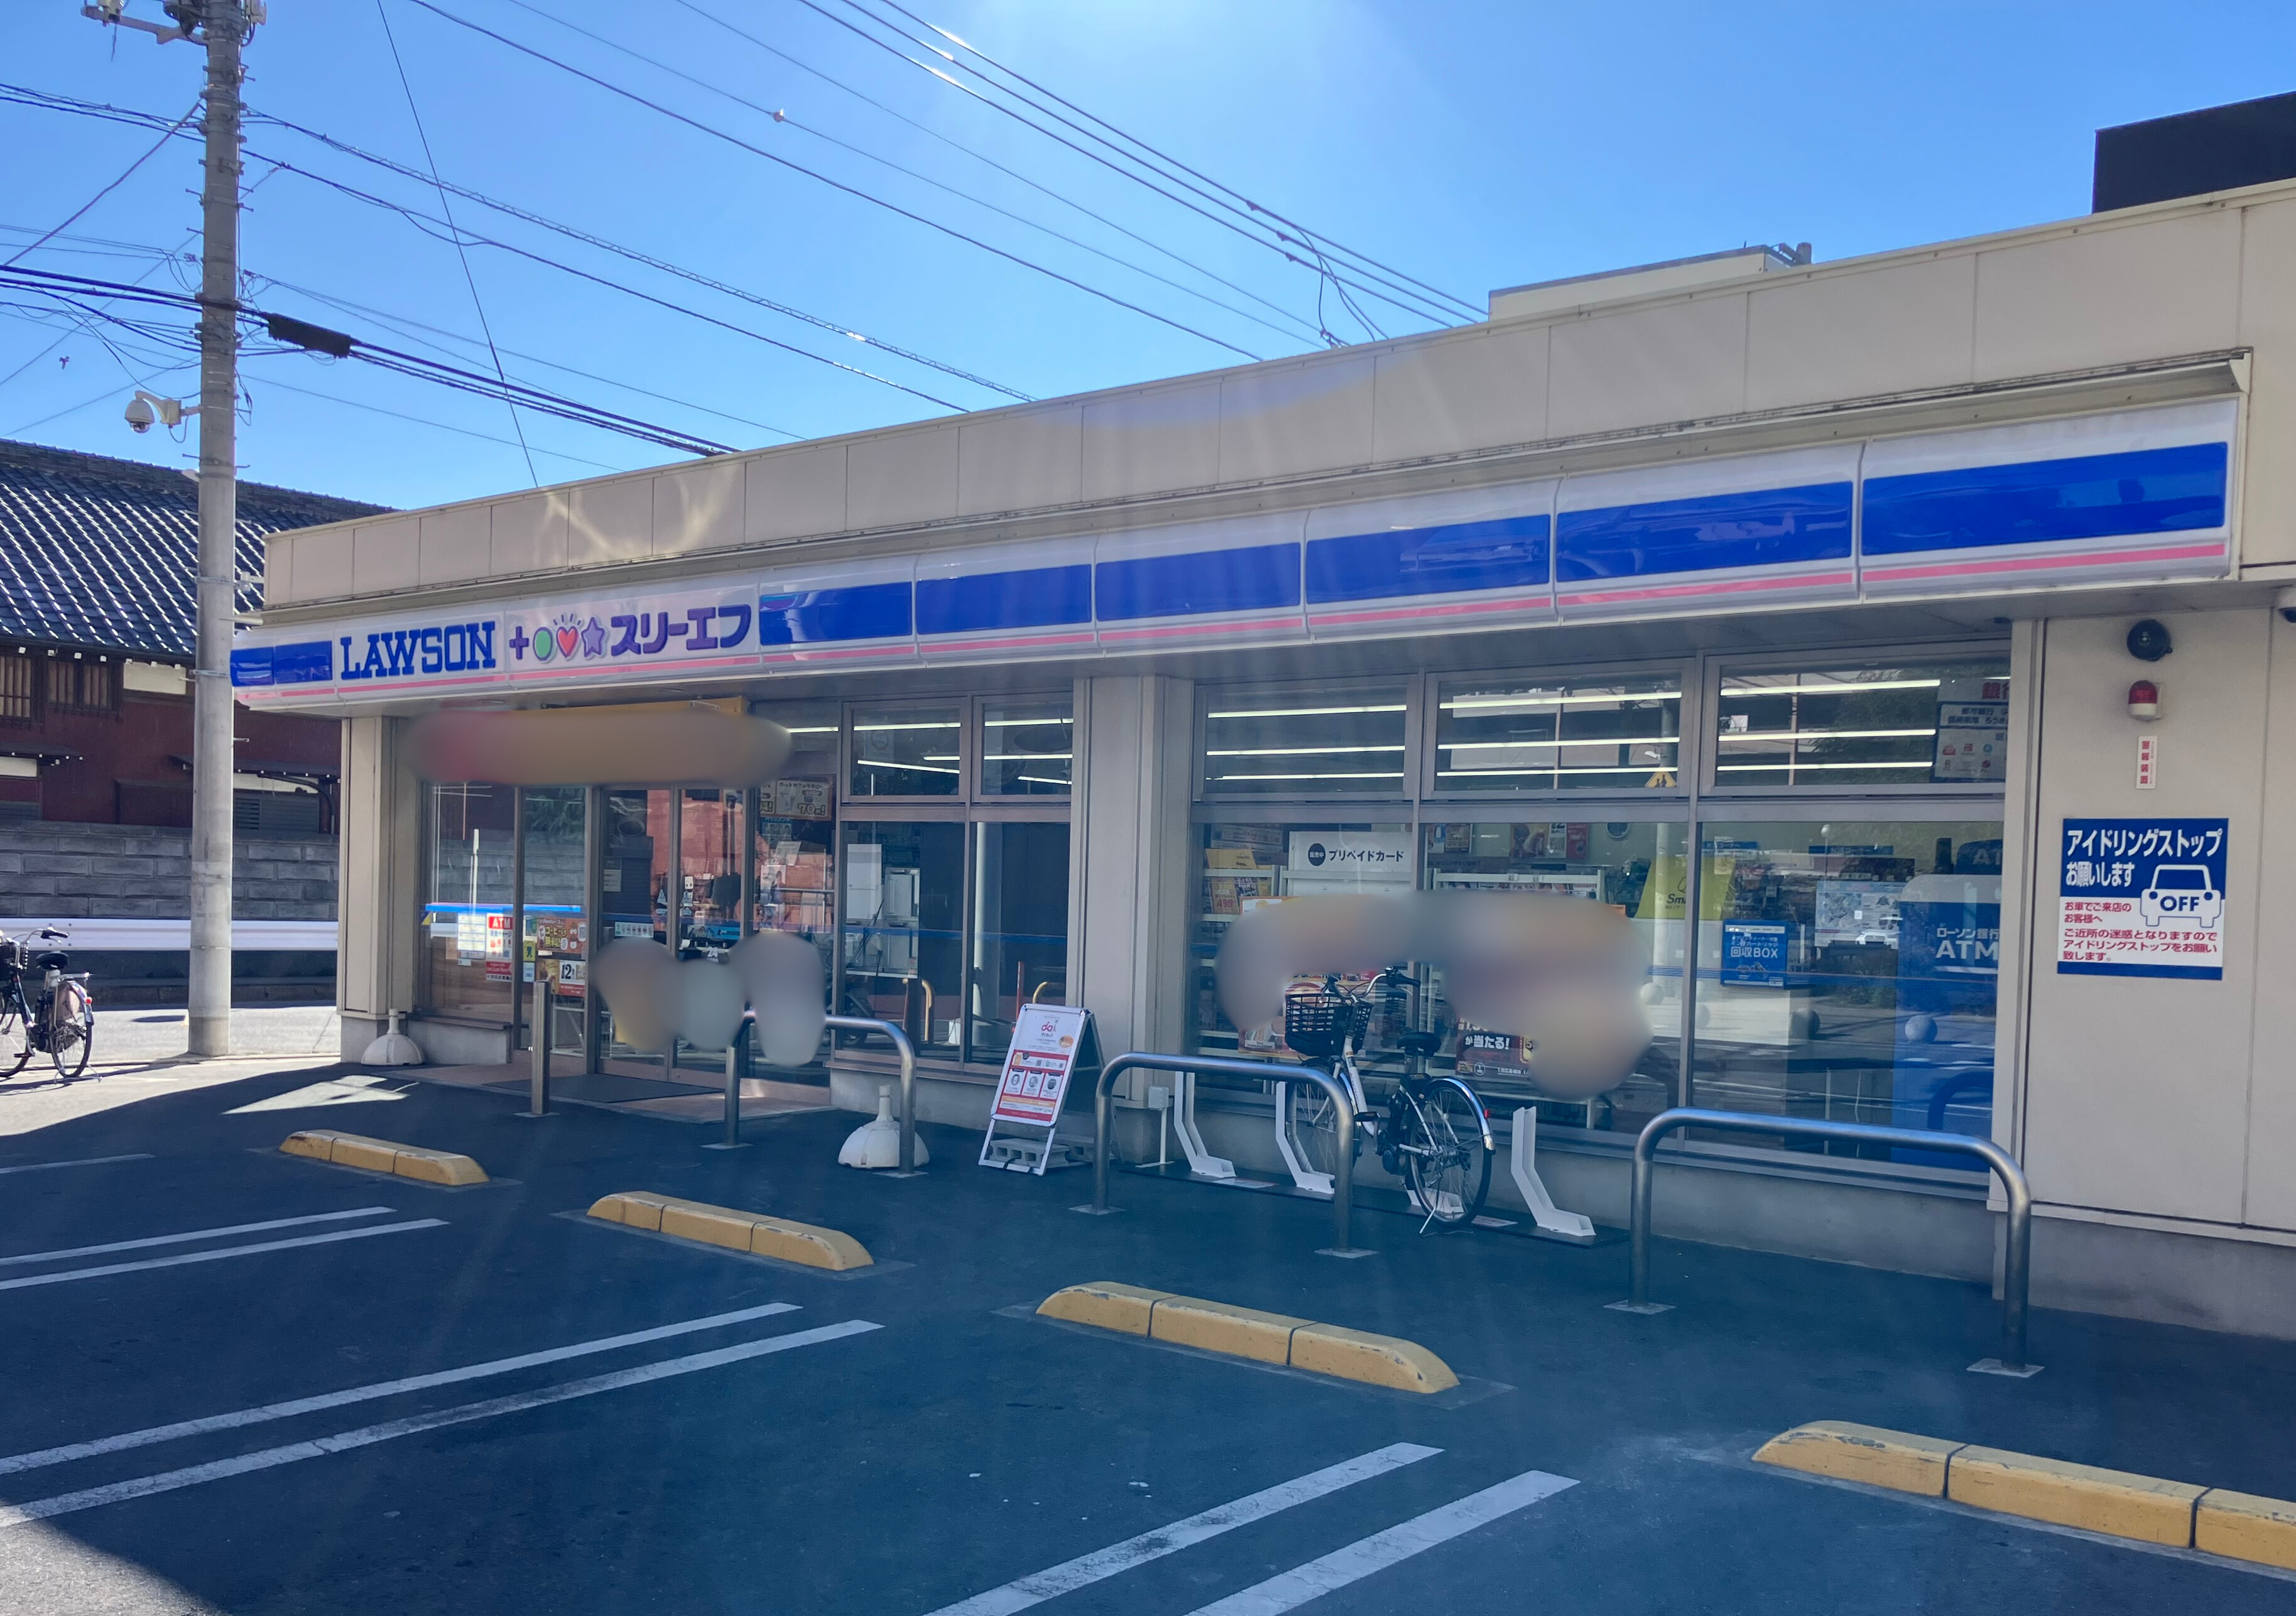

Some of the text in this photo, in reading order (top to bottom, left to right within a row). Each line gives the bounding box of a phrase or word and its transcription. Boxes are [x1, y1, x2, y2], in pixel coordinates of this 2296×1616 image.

[611, 604, 751, 657] スリーエフ
[340, 621, 496, 681] LAWSON
[2067, 828, 2223, 857] アイドリングストップ
[1329, 850, 1404, 862] プリペイドカード
[2065, 861, 2135, 887] お願いします
[2065, 901, 2132, 912] お車でご来店の
[2160, 896, 2199, 911] OFF
[492, 917, 511, 928] ATM
[2064, 914, 2103, 923] お客様へ
[1937, 928, 1999, 939] ローソン銀行
[2064, 929, 2217, 941] ご近所の迷惑となりますので
[1731, 946, 1778, 958] 回収BOX
[1935, 940, 1999, 960] ATM
[2064, 940, 2217, 953] アイドリングストップをお願い
[2063, 951, 2111, 962] 致します。
[1465, 1034, 1510, 1049] が当たる!
